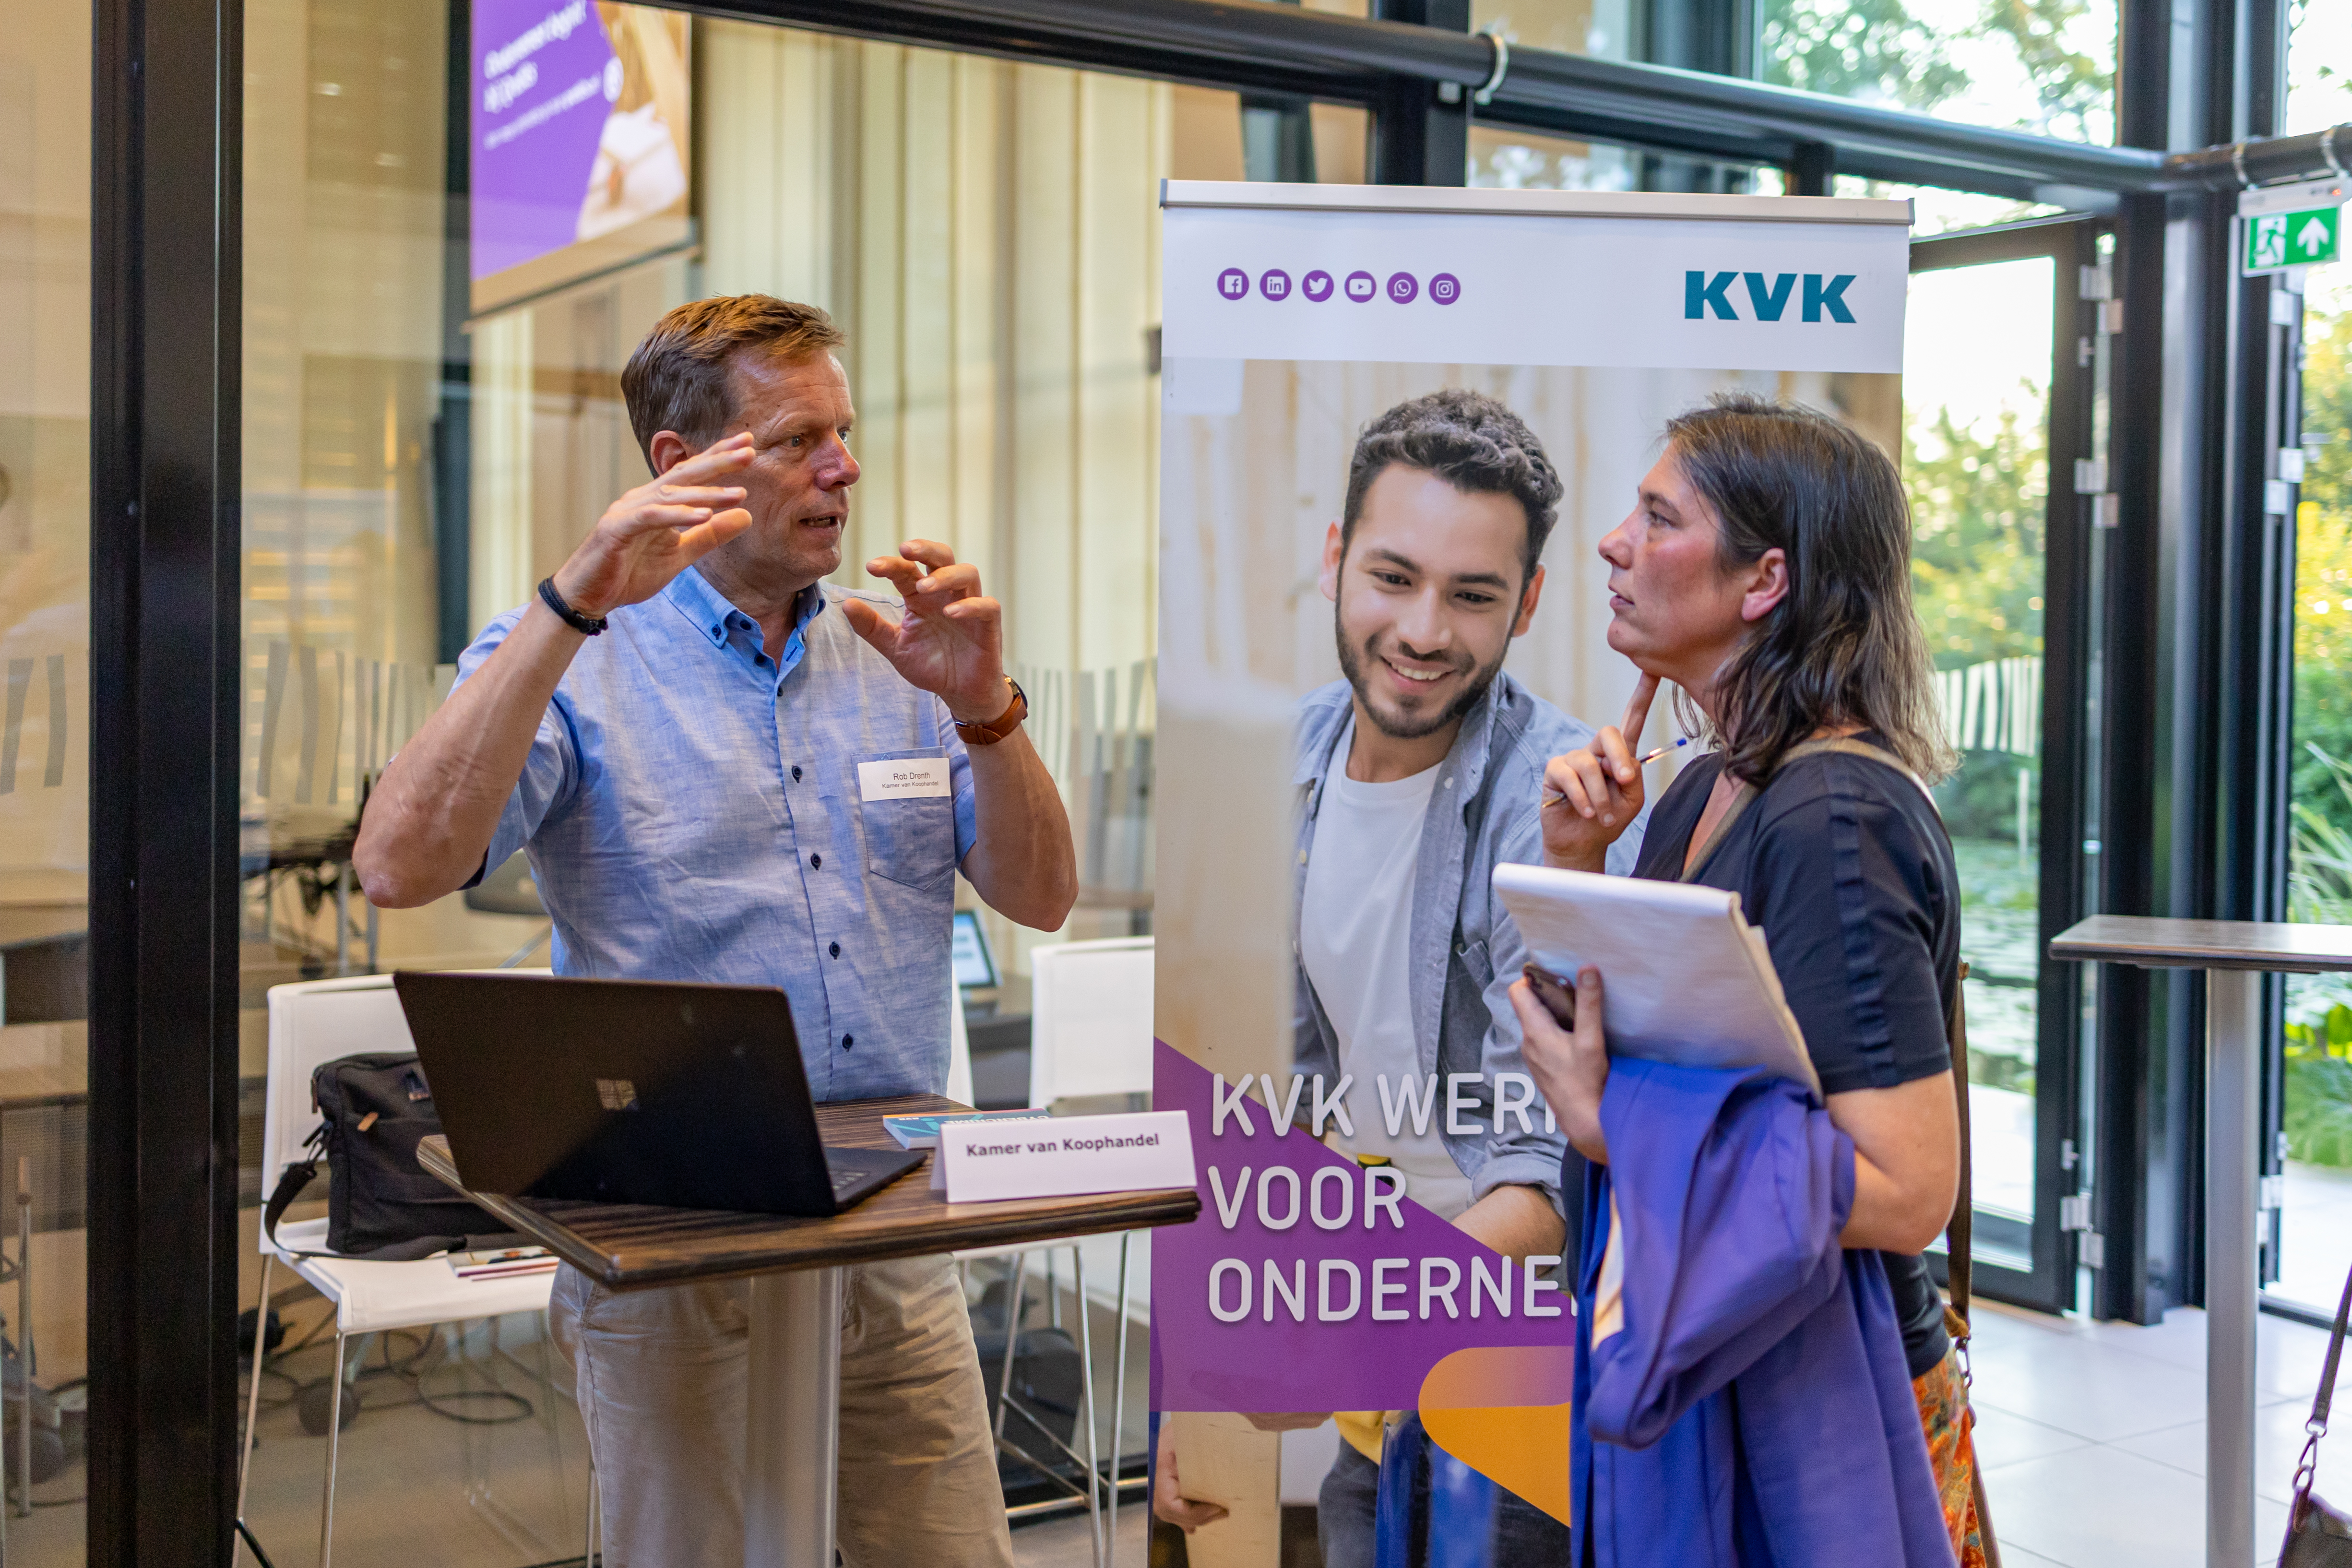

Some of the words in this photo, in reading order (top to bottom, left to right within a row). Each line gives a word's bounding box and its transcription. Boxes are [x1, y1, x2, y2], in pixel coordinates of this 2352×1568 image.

[1685, 270, 1857, 323] KVK
[1212, 1073, 1354, 1137] KVK
[1377, 1073, 1557, 1136] WER
[966, 1143, 1021, 1157] Kamer
[1028, 1140, 1057, 1152] van
[1062, 1133, 1160, 1152] Koophandel
[1207, 1166, 1407, 1230] VOOR
[1208, 1255, 1577, 1322] ONDERNE
